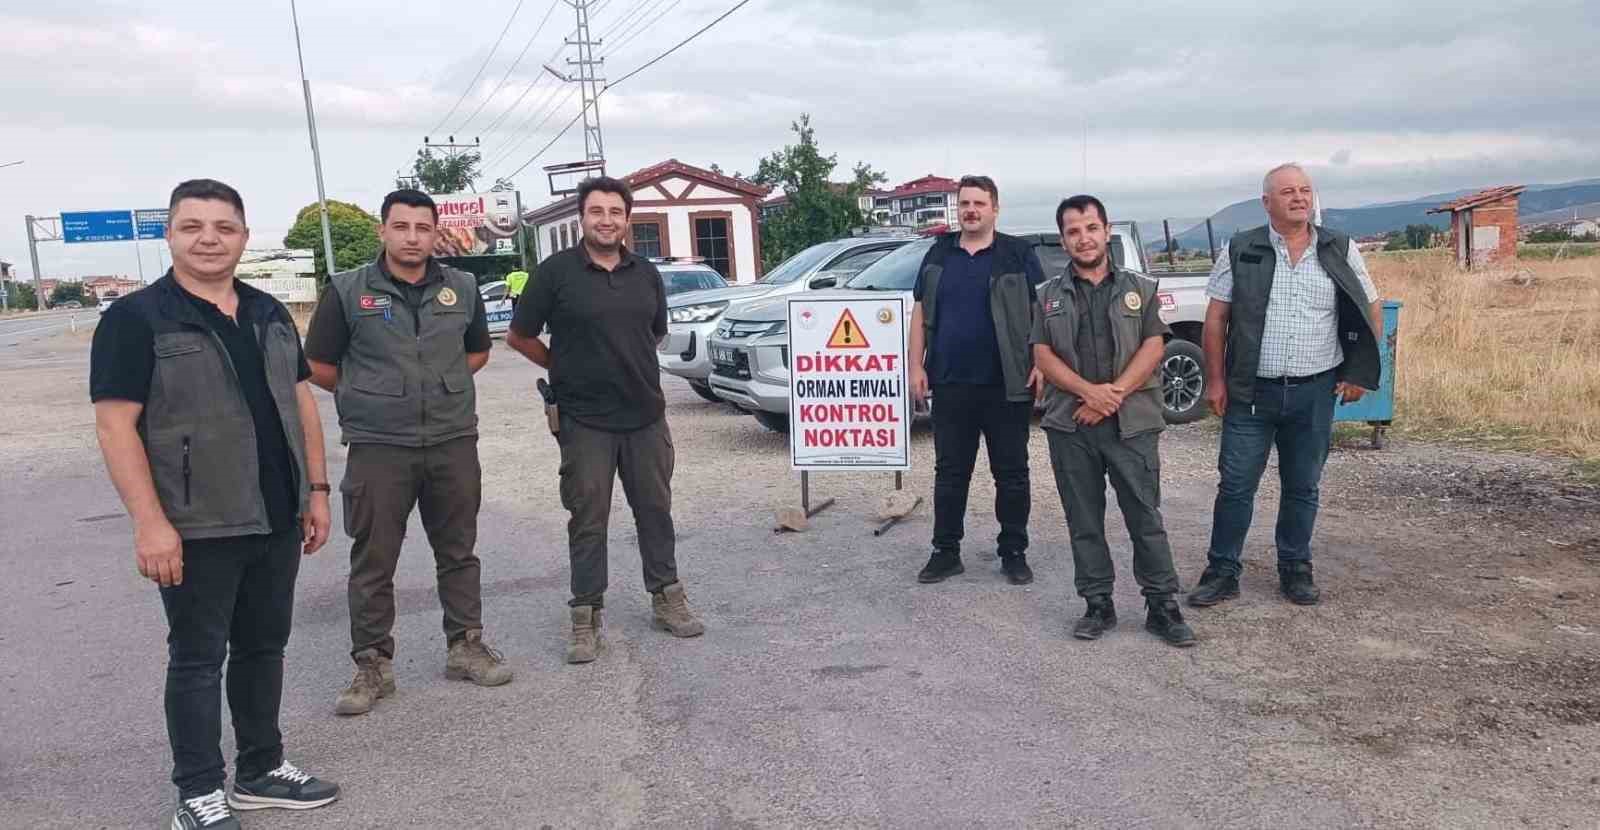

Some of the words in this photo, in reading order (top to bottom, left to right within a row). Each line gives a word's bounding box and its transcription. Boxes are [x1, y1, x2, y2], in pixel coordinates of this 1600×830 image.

[796, 351, 898, 372] DİKKAT
[797, 379, 846, 398] ORMAN
[850, 374, 900, 398] EMVALİ
[800, 404, 899, 423] KONTROL
[804, 428, 896, 447] NOKTASI
